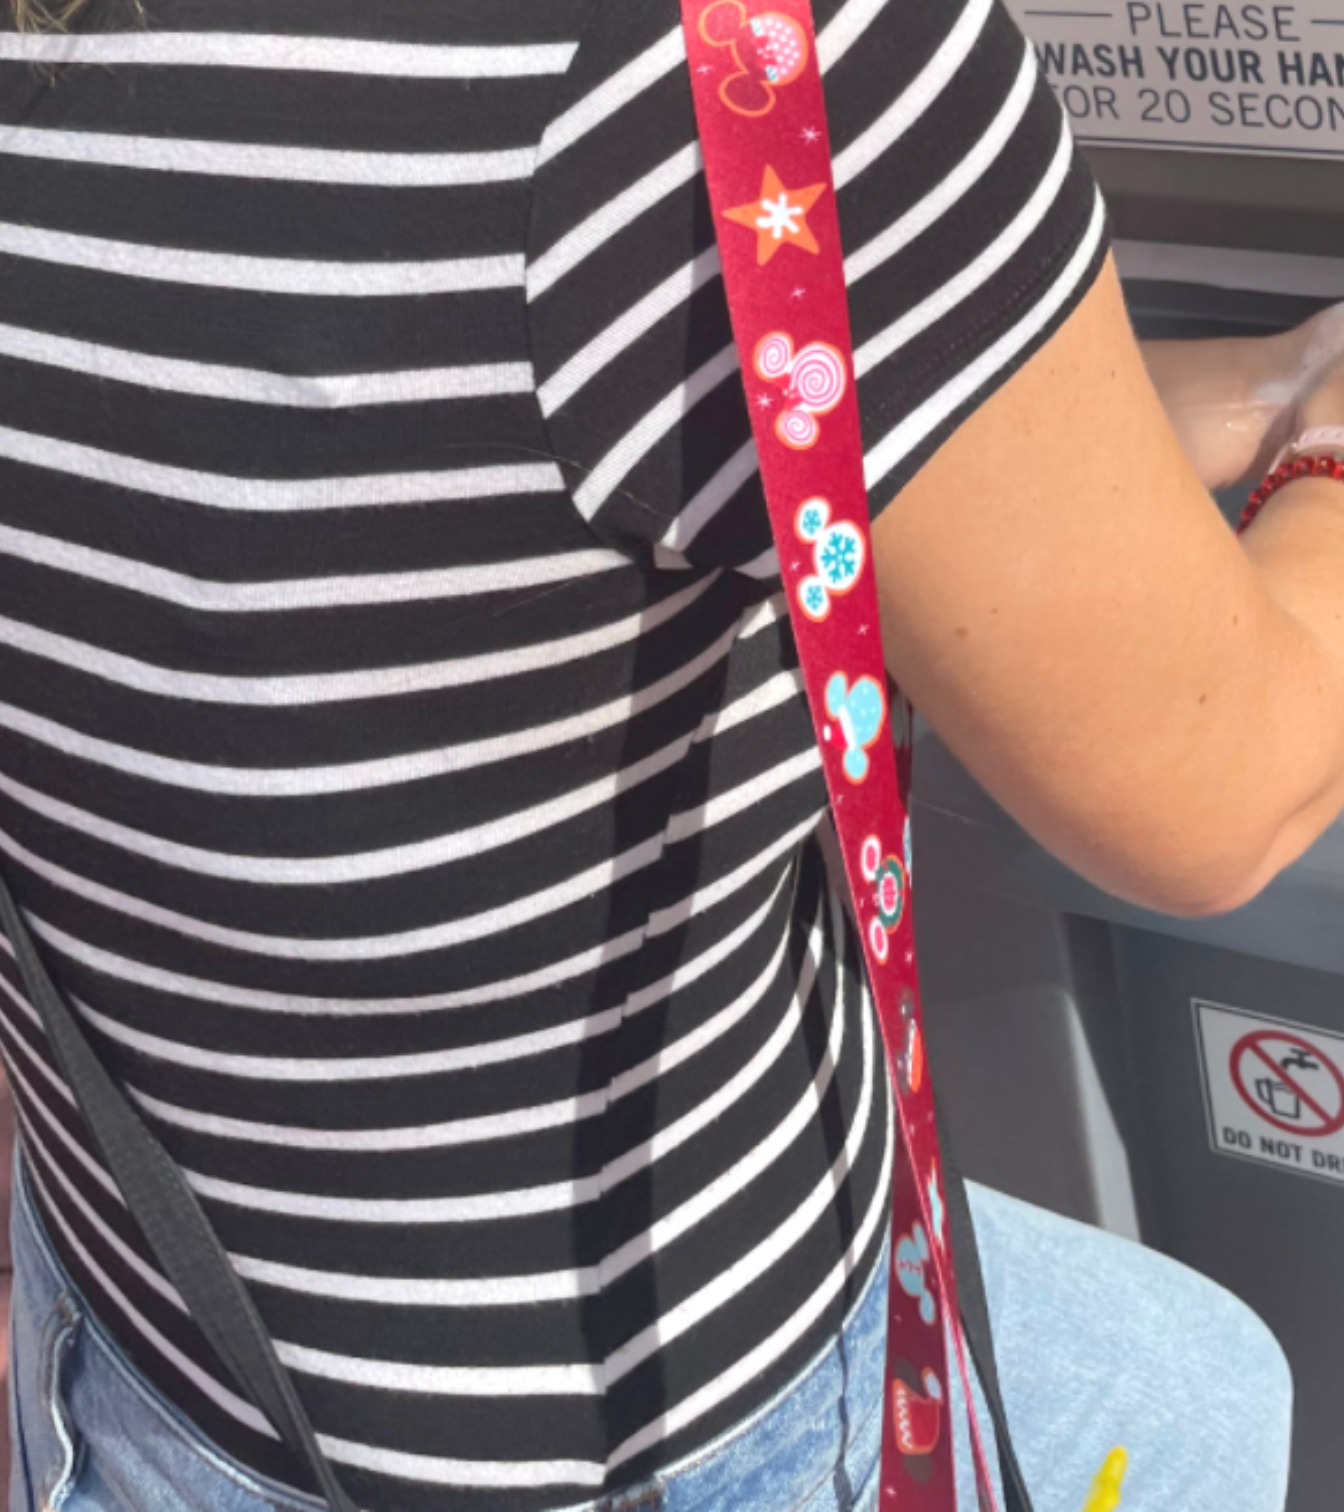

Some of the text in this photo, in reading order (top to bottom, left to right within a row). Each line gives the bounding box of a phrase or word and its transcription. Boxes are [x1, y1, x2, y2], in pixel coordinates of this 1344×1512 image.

[1126, 1, 1301, 42] PLEASE
[1034, 42, 1145, 79] WASH
[1156, 46, 1265, 85] YOUR
[1050, 84, 1120, 121] OR
[1137, 89, 1192, 124] 20
[1222, 1126, 1252, 1149] DO
[1259, 1135, 1305, 1163] NOT
